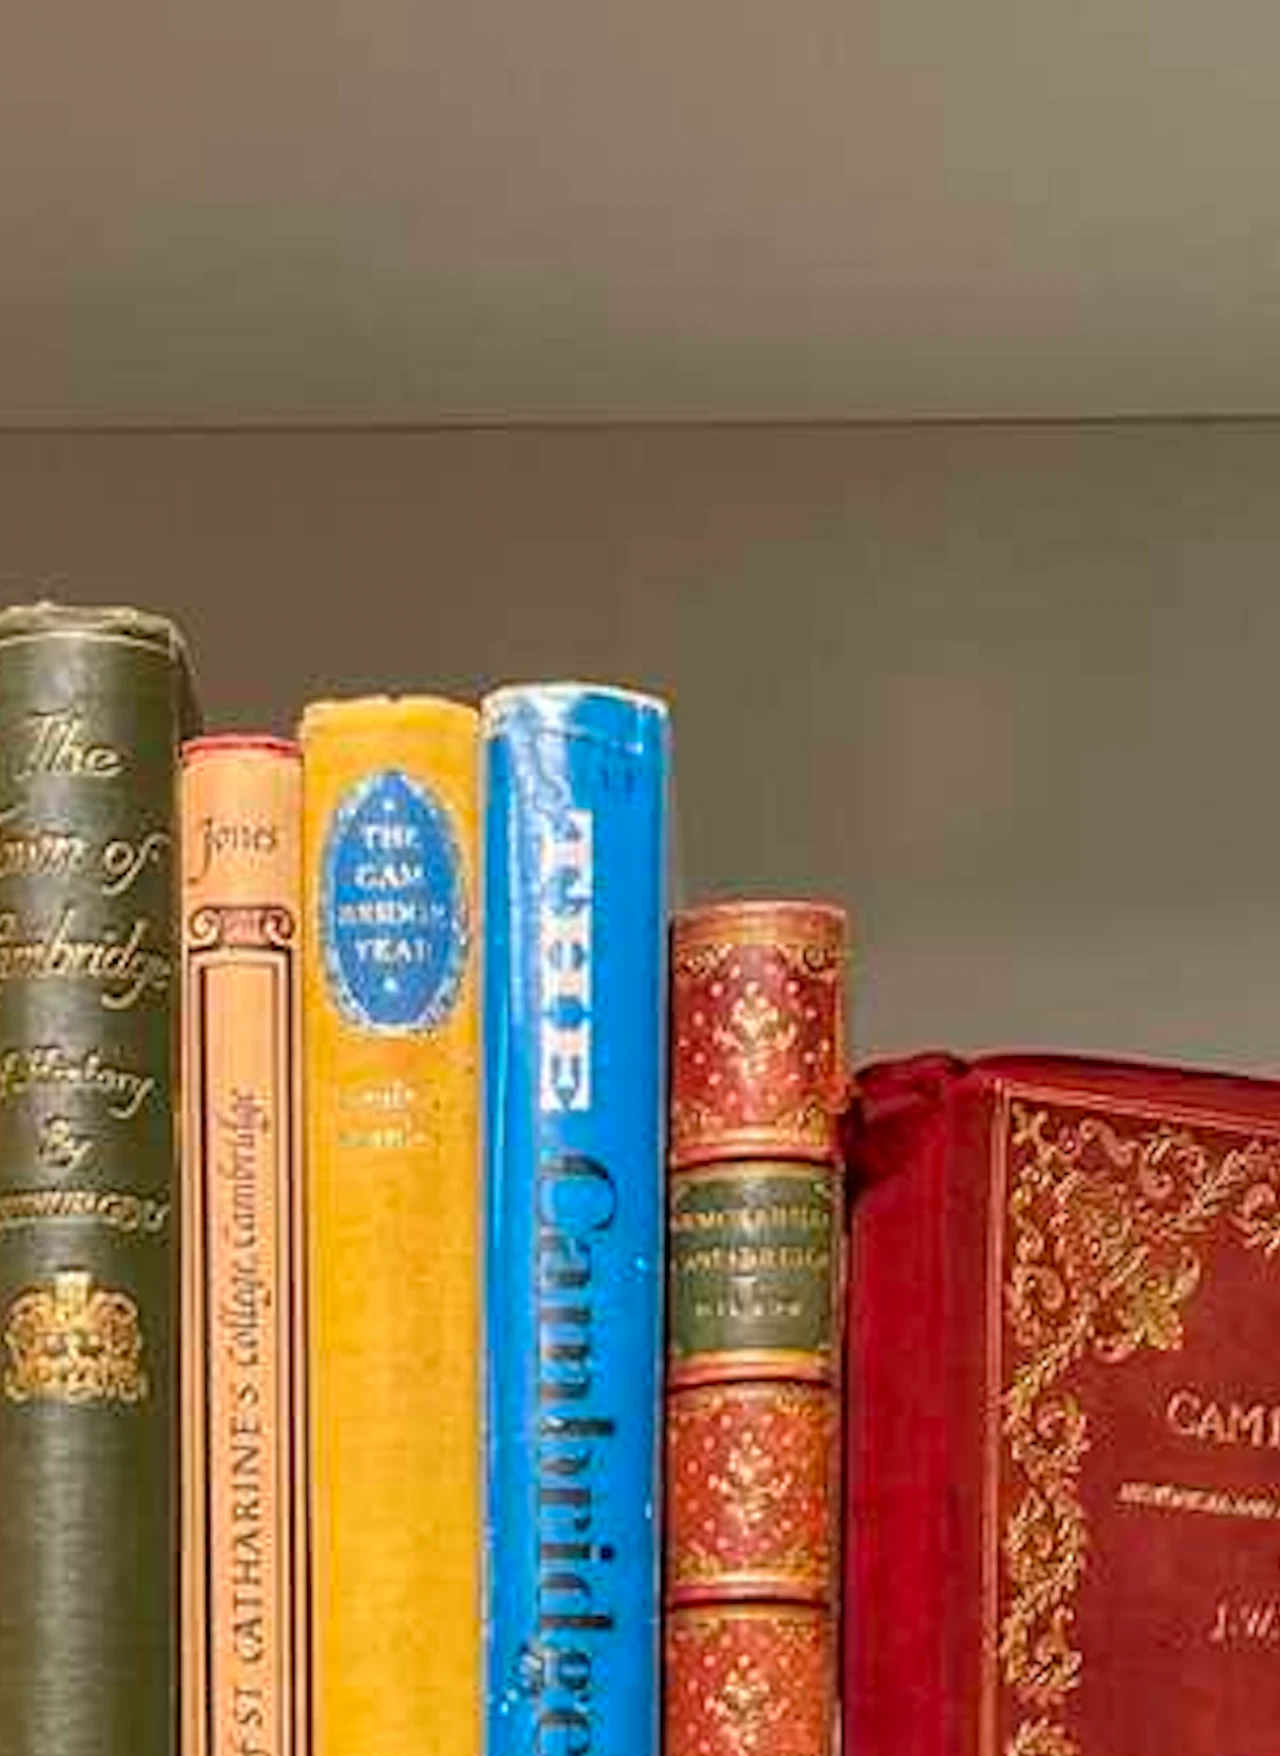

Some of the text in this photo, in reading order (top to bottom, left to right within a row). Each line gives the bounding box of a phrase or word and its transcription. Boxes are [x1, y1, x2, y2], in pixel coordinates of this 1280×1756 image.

[12, 707, 128, 782] The
[101, 830, 171, 896] of
[188, 817, 278, 884] Jones
[540, 808, 592, 1110] THE
[218, 1089, 270, 1248] Cambridge
[233, 1686, 264, 1729] ST
